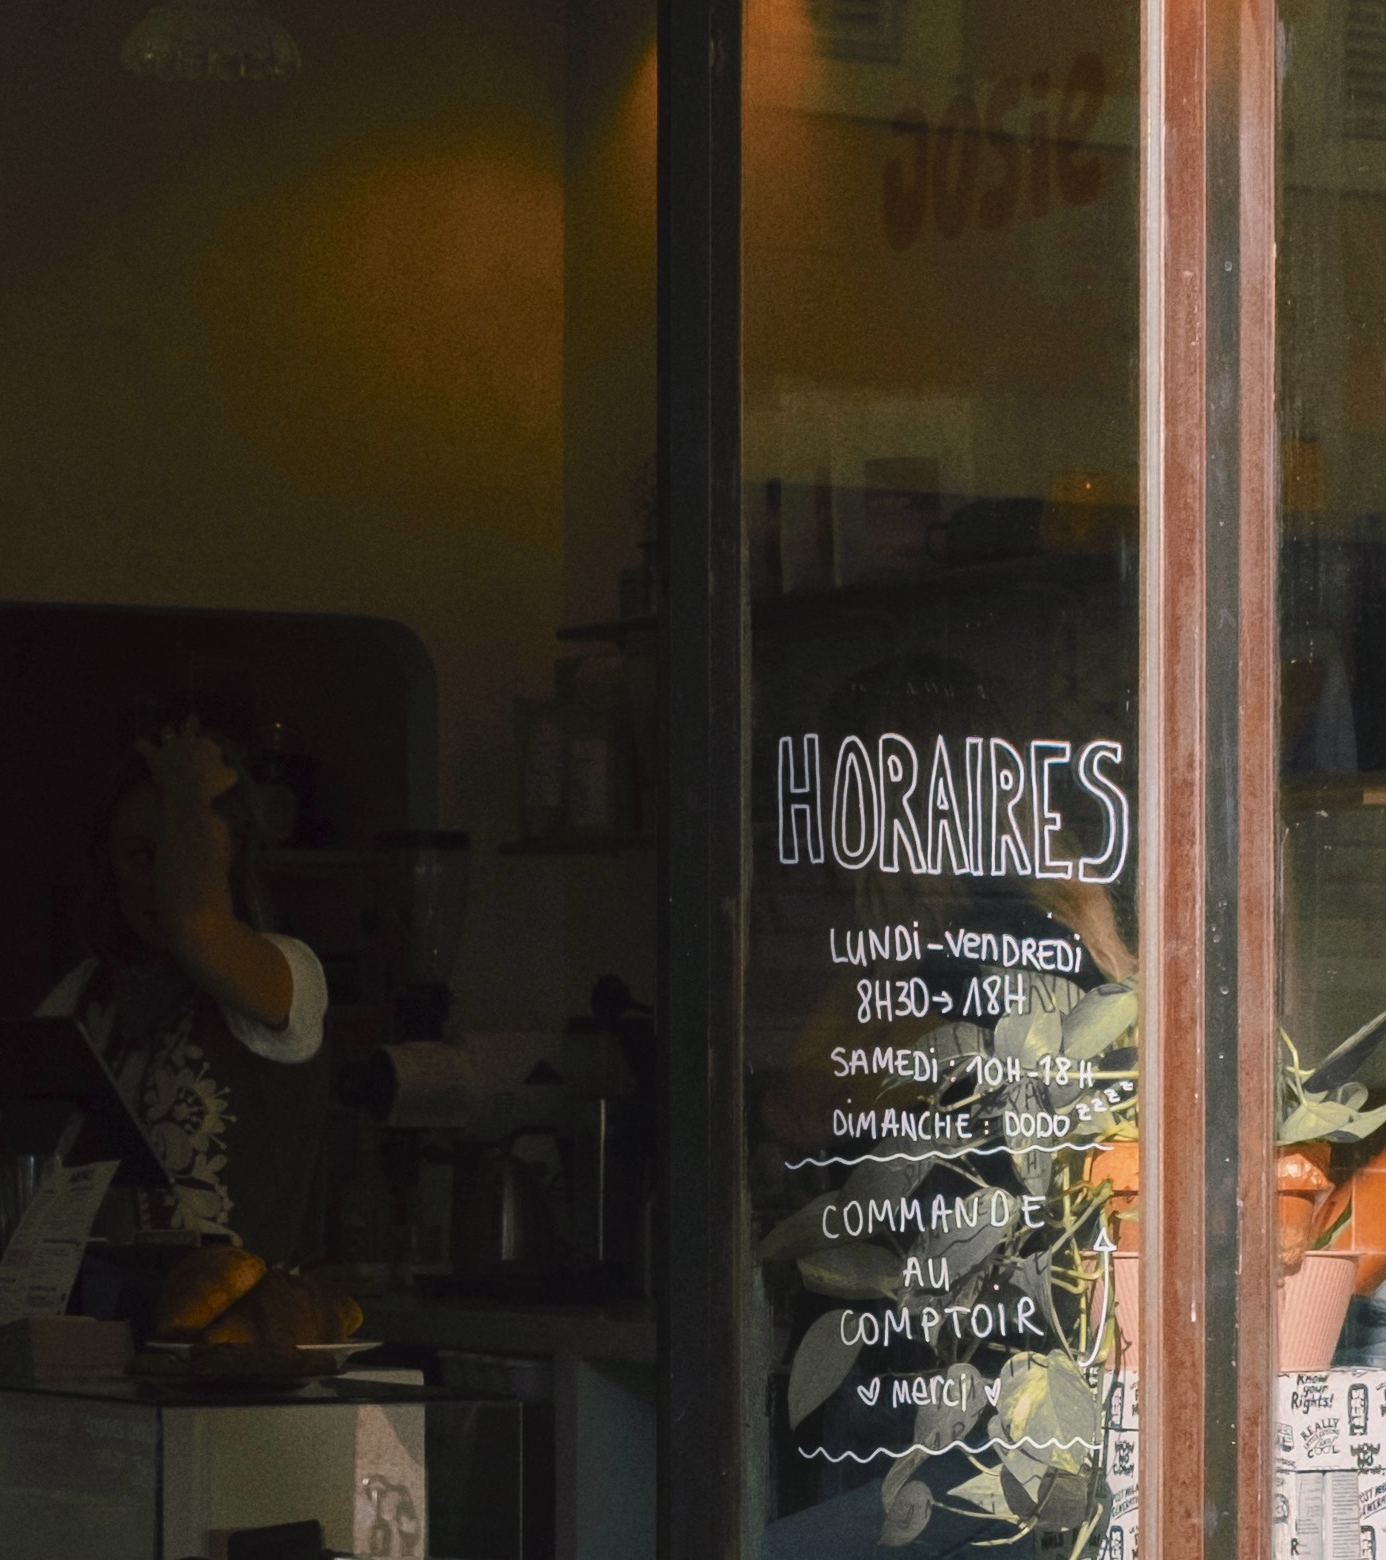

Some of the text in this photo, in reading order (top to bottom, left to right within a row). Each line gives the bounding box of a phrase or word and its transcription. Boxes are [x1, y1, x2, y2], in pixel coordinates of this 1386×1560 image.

[778, 732, 1129, 883] HORAIRES
[1004, 1111, 1070, 1138] DODO
[822, 1190, 1046, 1239] COMMANDE
[903, 1257, 949, 1292] AU
